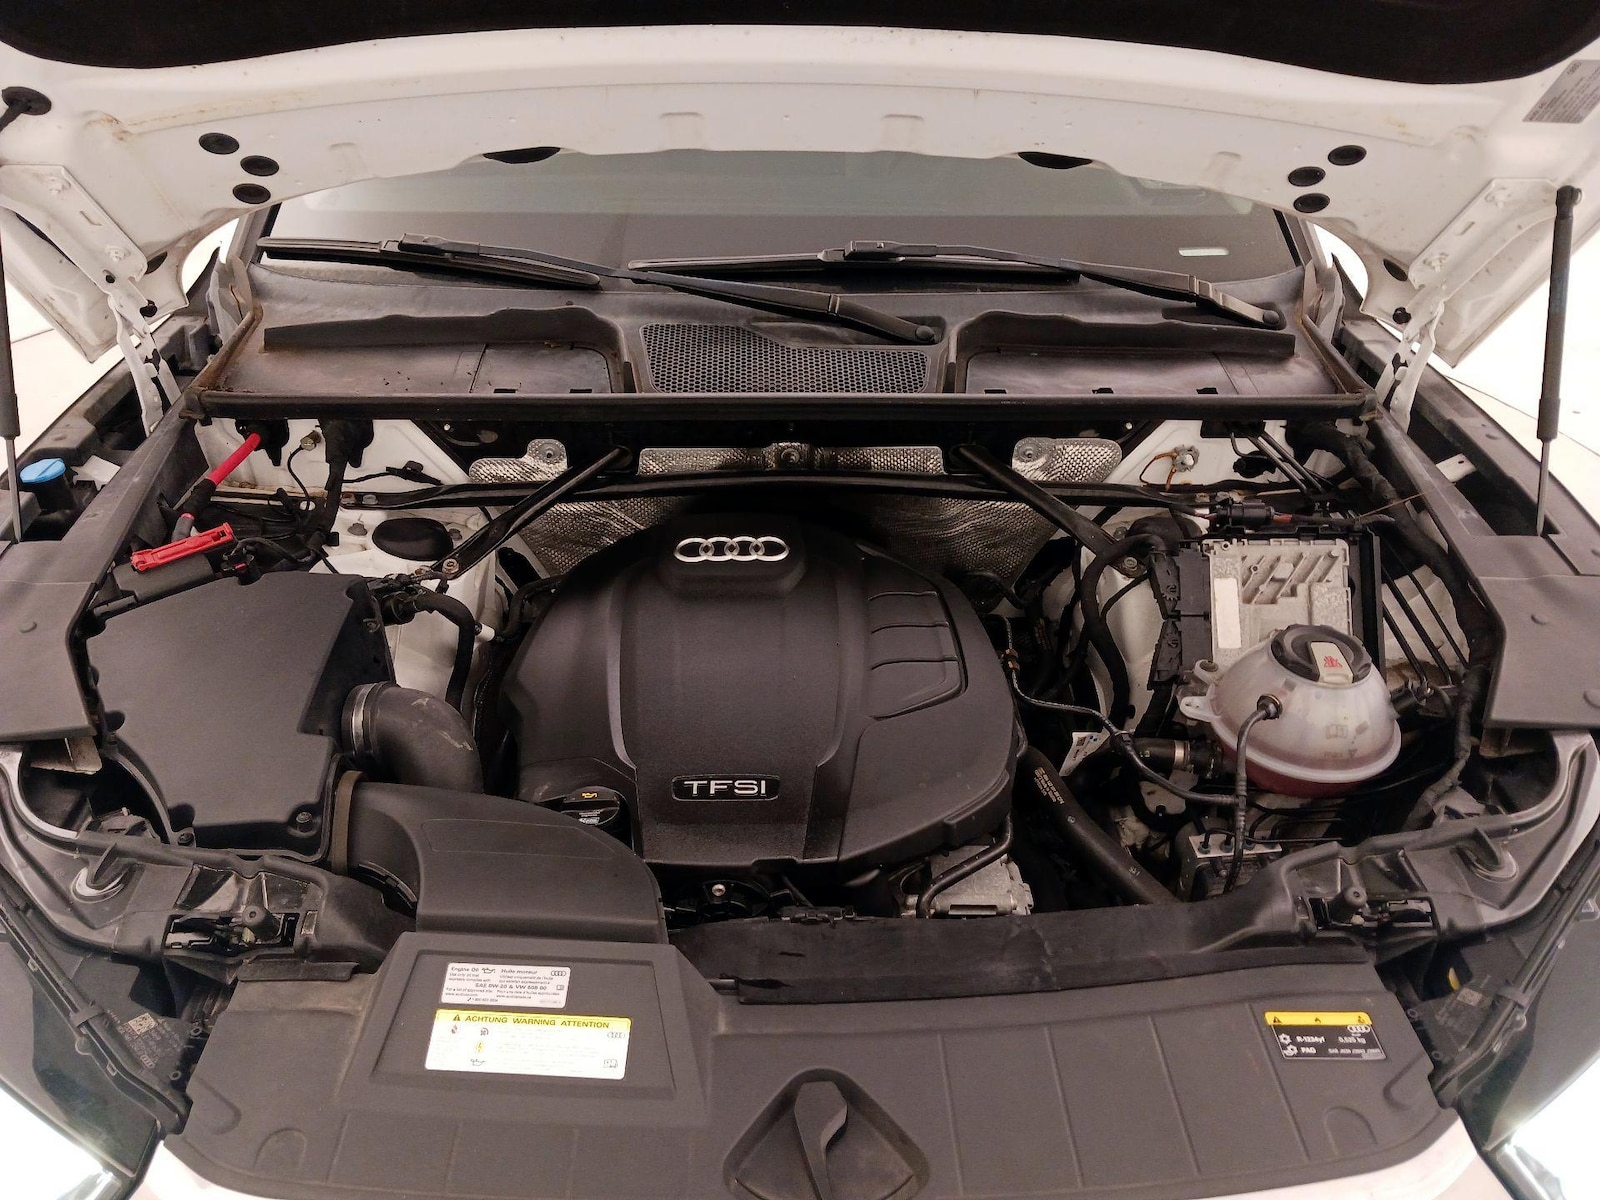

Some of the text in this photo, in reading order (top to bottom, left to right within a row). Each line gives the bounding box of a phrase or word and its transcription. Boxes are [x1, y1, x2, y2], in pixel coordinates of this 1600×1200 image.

[683, 780, 767, 796] TFSI
[465, 1015, 610, 1028] ACHTUNG WARNING ATTENTION
